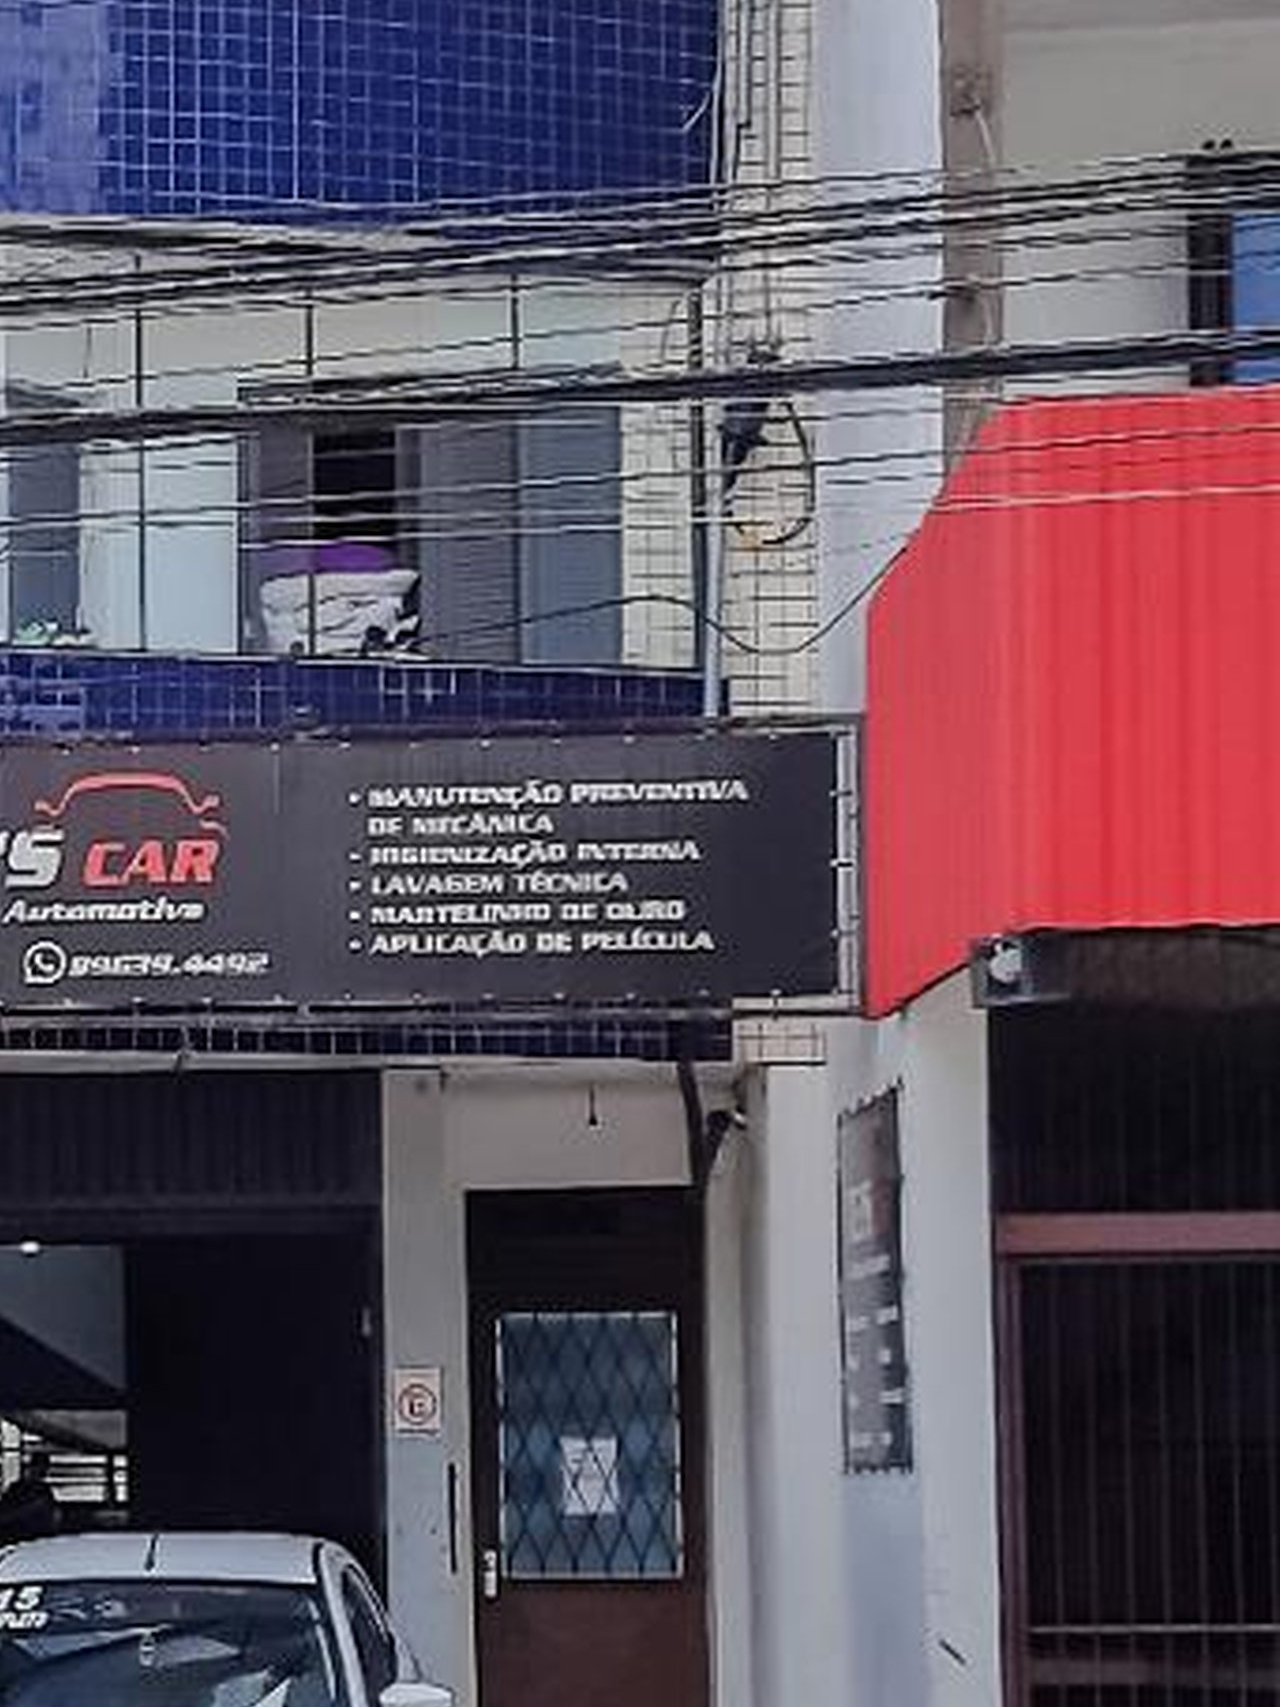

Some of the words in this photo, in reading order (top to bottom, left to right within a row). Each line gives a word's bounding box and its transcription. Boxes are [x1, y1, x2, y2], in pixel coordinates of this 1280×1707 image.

[571, 780, 750, 804] PREVENTIVA
[367, 816, 403, 836] DE
[576, 840, 702, 862] INTERNA
[83, 838, 221, 887] CAR
[370, 874, 505, 896] LAVAGEM
[560, 900, 597, 921] DE
[606, 898, 686, 921] OURO
[536, 931, 573, 953] DE
